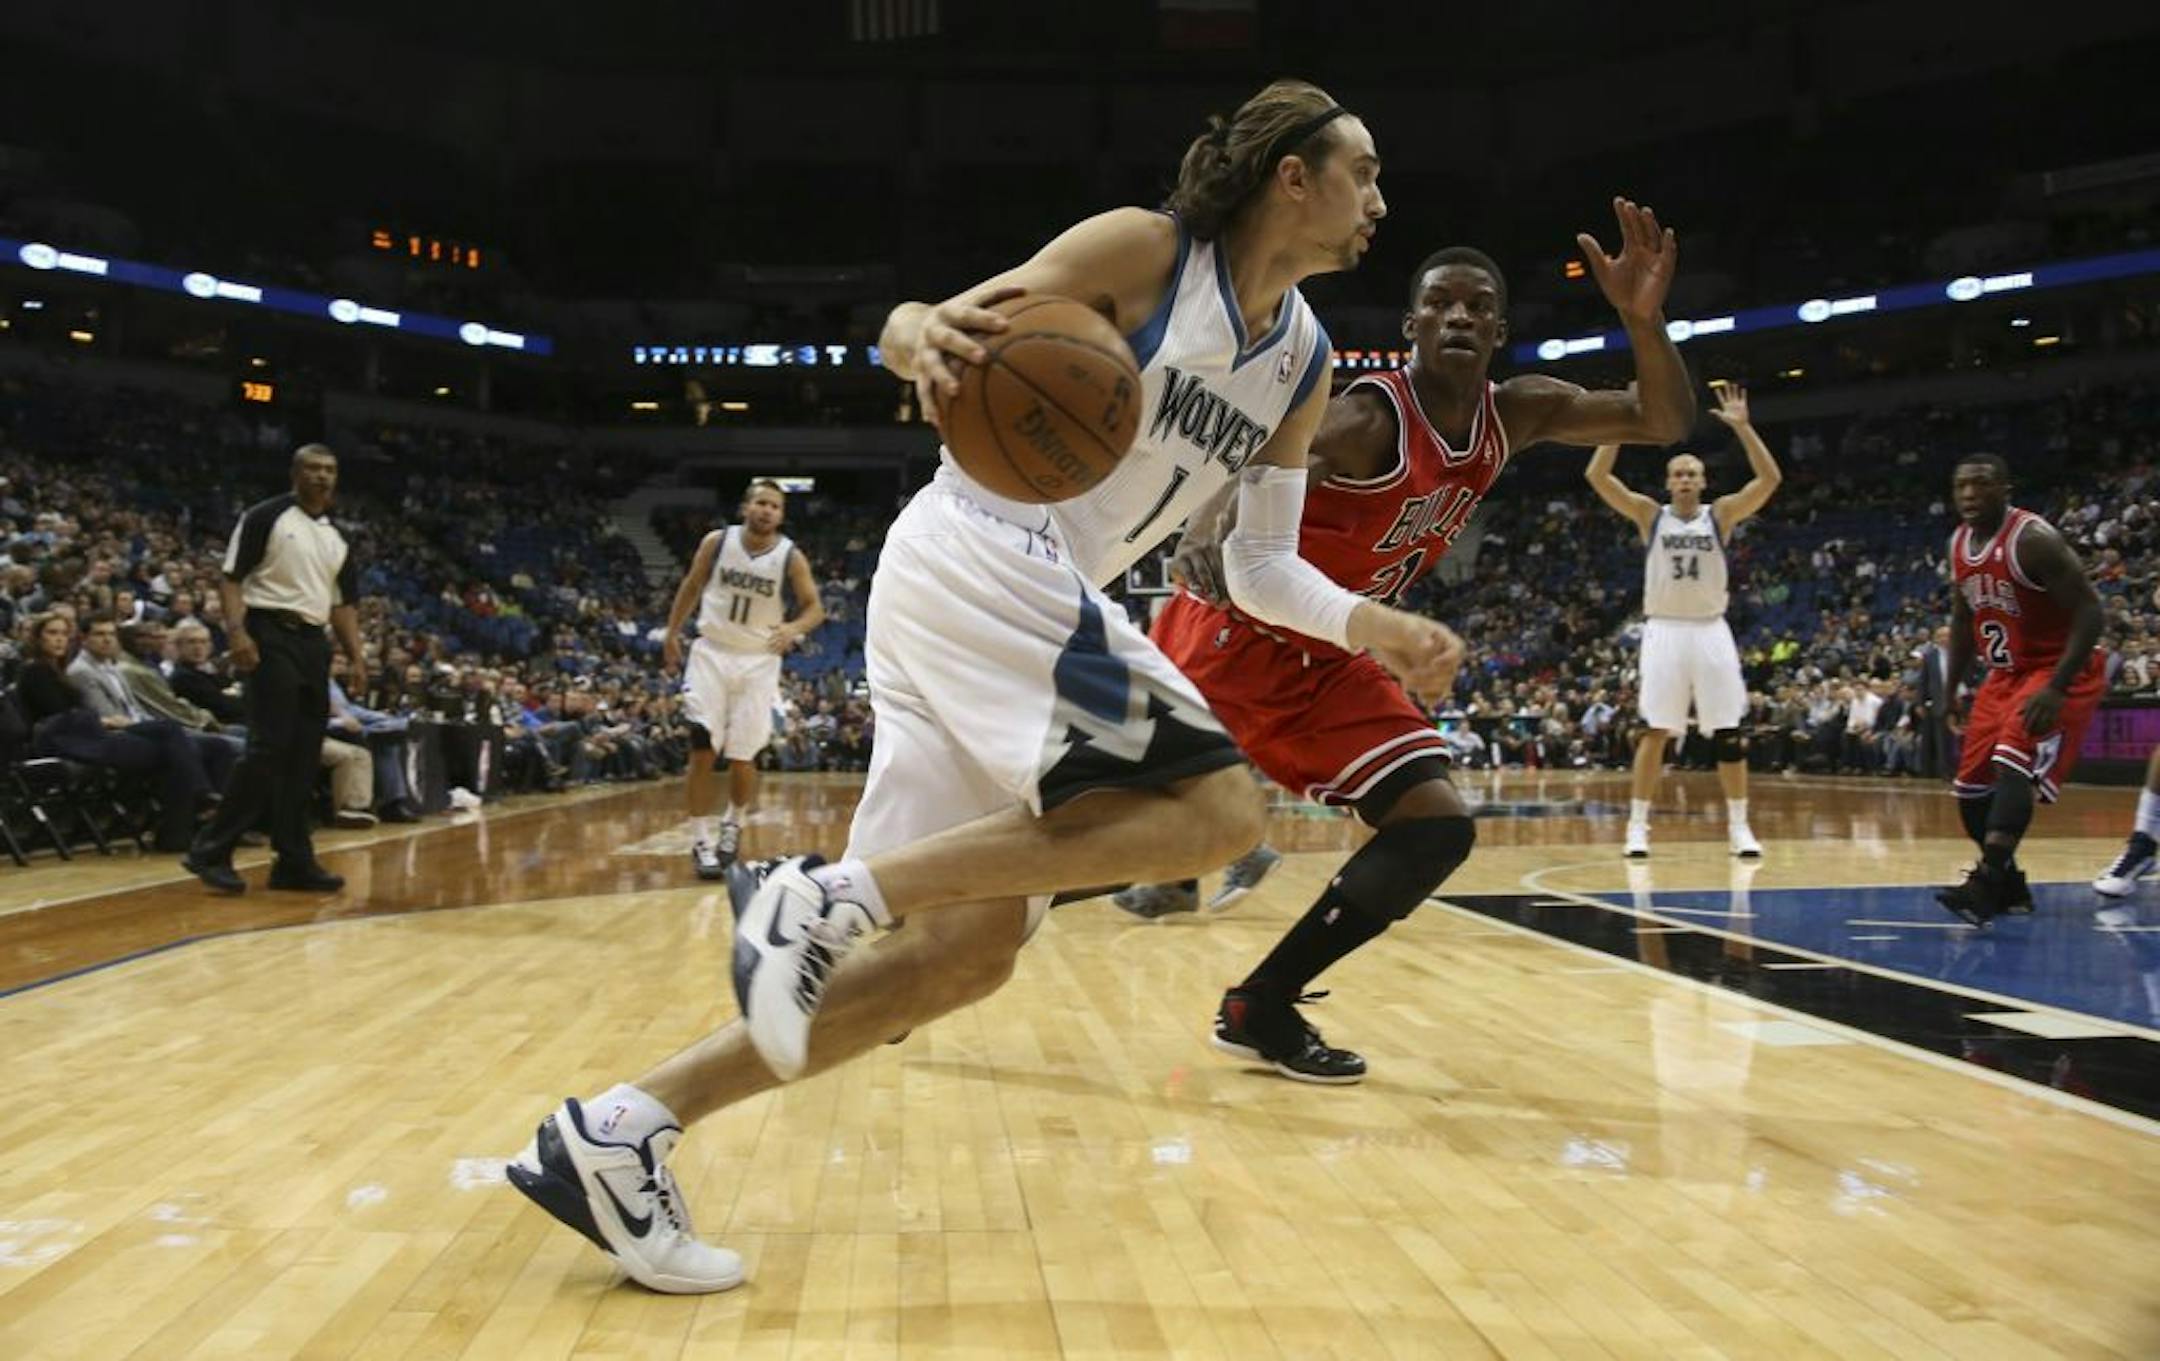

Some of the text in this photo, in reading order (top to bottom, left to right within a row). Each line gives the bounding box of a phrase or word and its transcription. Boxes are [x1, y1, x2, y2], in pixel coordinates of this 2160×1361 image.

[1148, 366, 1268, 474] WOLVES
[1125, 464, 1190, 543] 1
[1661, 533, 1713, 552] WOLVES
[719, 566, 777, 598] WOLVES
[1672, 555, 1699, 581] 34
[729, 593, 752, 625] 11
[1979, 620, 2014, 668] 2
